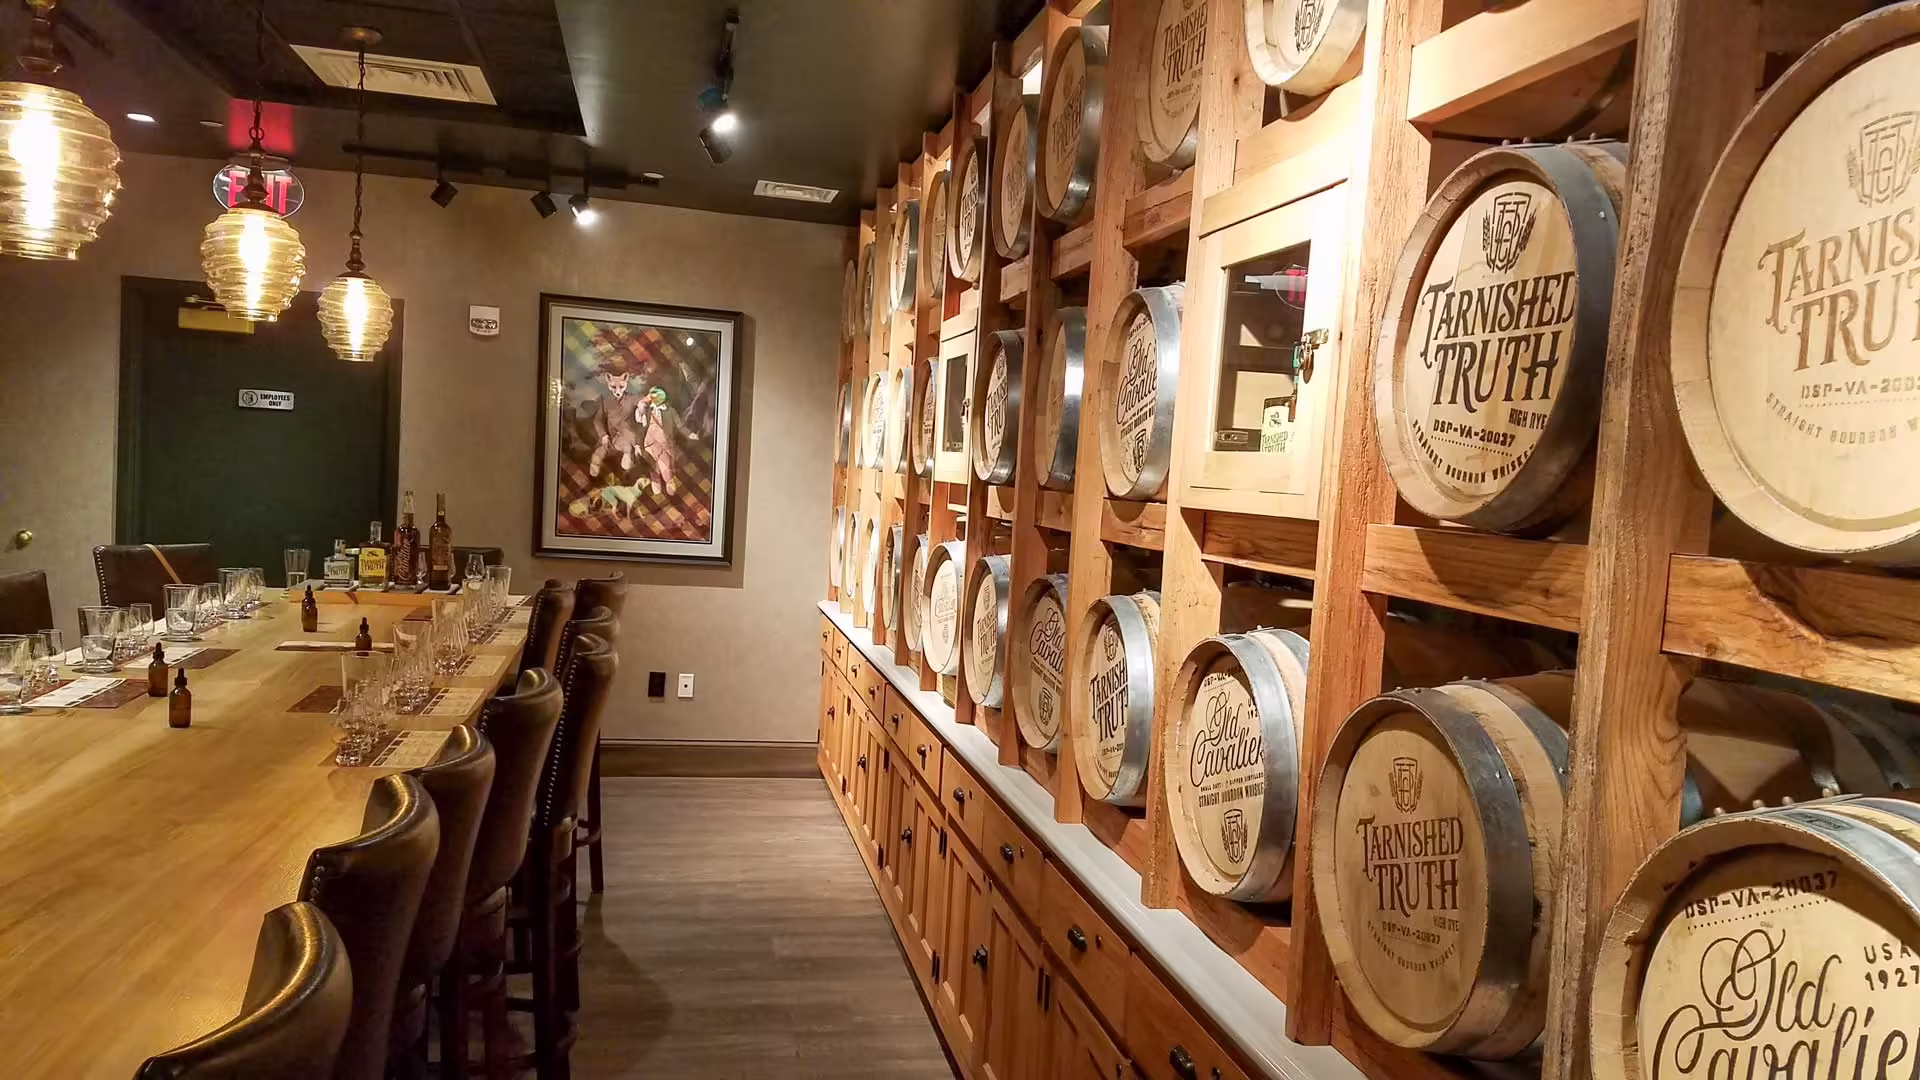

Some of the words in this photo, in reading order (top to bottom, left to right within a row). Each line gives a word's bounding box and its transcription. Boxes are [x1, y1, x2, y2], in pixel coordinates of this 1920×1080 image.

[1162, 1, 1208, 71] TARNISHE
[1166, 27, 1207, 87] TRUTH
[228, 170, 293, 216] EIT
[1757, 206, 1920, 335] TARNIS
[1420, 271, 1577, 369] TARNISHED
[260, 393, 291, 401] EMPLOYEES
[1432, 330, 1564, 413] TRUTH
[1433, 419, 1516, 448] DSP-VA-20037
[1508, 407, 1528, 428] HIGH
[1766, 392, 1823, 438] STRAIGHT
[1830, 425, 1897, 444] BOURBON
[1445, 464, 1487, 484] BOURBON
[1089, 657, 1129, 724] TARNISH
[1206, 690, 1244, 746] Old
[1190, 727, 1264, 788] Cavalier
[1244, 781, 1264, 798] WHISKE
[1356, 814, 1464, 882] TARNISHED
[1373, 859, 1459, 918] TRUTH
[1684, 870, 1838, 919] DSP-VA-20037
[1863, 940, 1912, 964] USA
[1864, 964, 1920, 991] 1927
[1700, 928, 1842, 1041] Old
[1652, 1004, 1920, 1080] Cavalie
